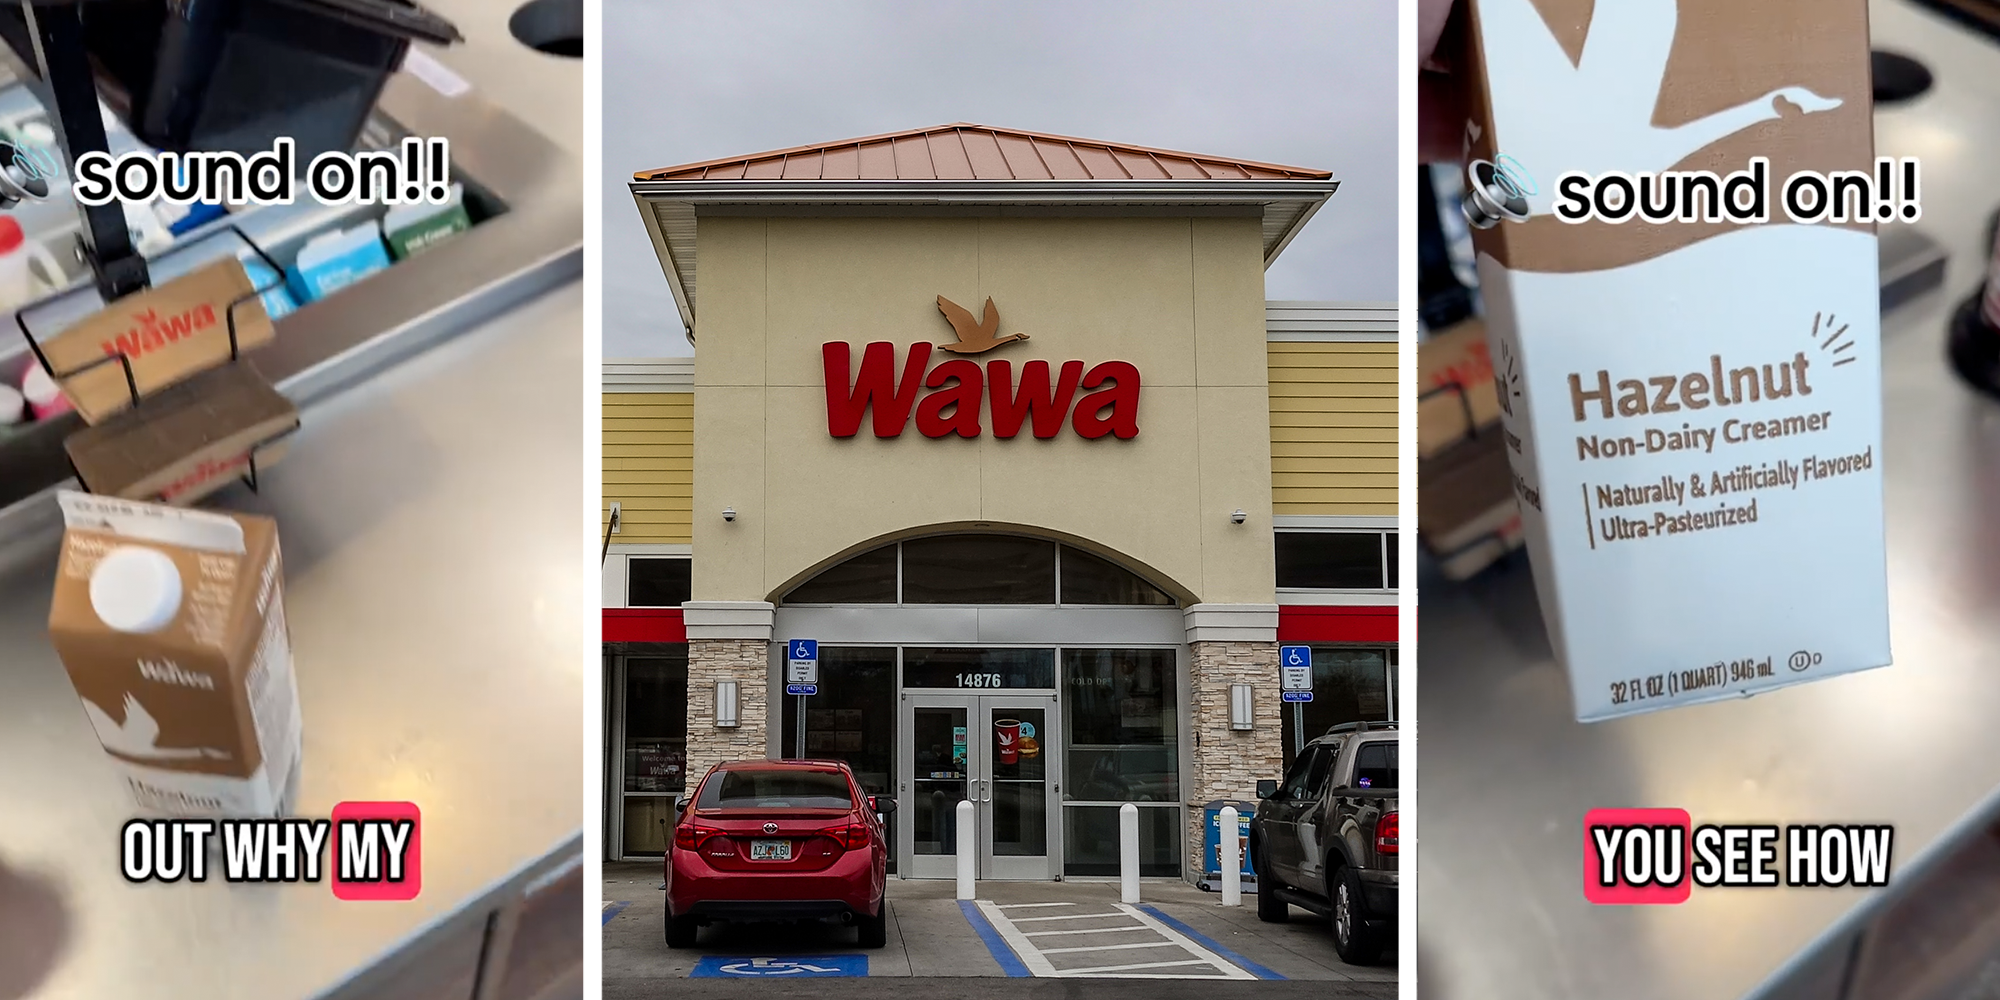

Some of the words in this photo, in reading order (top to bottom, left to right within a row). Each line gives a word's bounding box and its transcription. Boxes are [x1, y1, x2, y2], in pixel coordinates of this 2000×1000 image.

[821, 340, 1141, 439] Wawa
[1568, 352, 1813, 422] Hazelnut
[1576, 422, 1716, 461] Non-Dairy
[1722, 411, 1831, 444] Creamer
[1596, 475, 1686, 509] Naturally
[1689, 473, 1706, 499] &
[1710, 460, 1799, 497] Artificially
[1802, 445, 1873, 482] Flavored
[1600, 498, 1759, 541] Ultra-Pasteurized
[955, 672, 1002, 688] 14876
[1071, 677, 1093, 686] COLD
[1610, 681, 1628, 705] 32
[1630, 678, 1646, 701] FL
[1646, 673, 1664, 697] OZ
[1667, 671, 1679, 697] (1
[1681, 661, 1727, 692] QUART)
[1731, 658, 1755, 682] 946
[1756, 656, 1776, 677] mL
